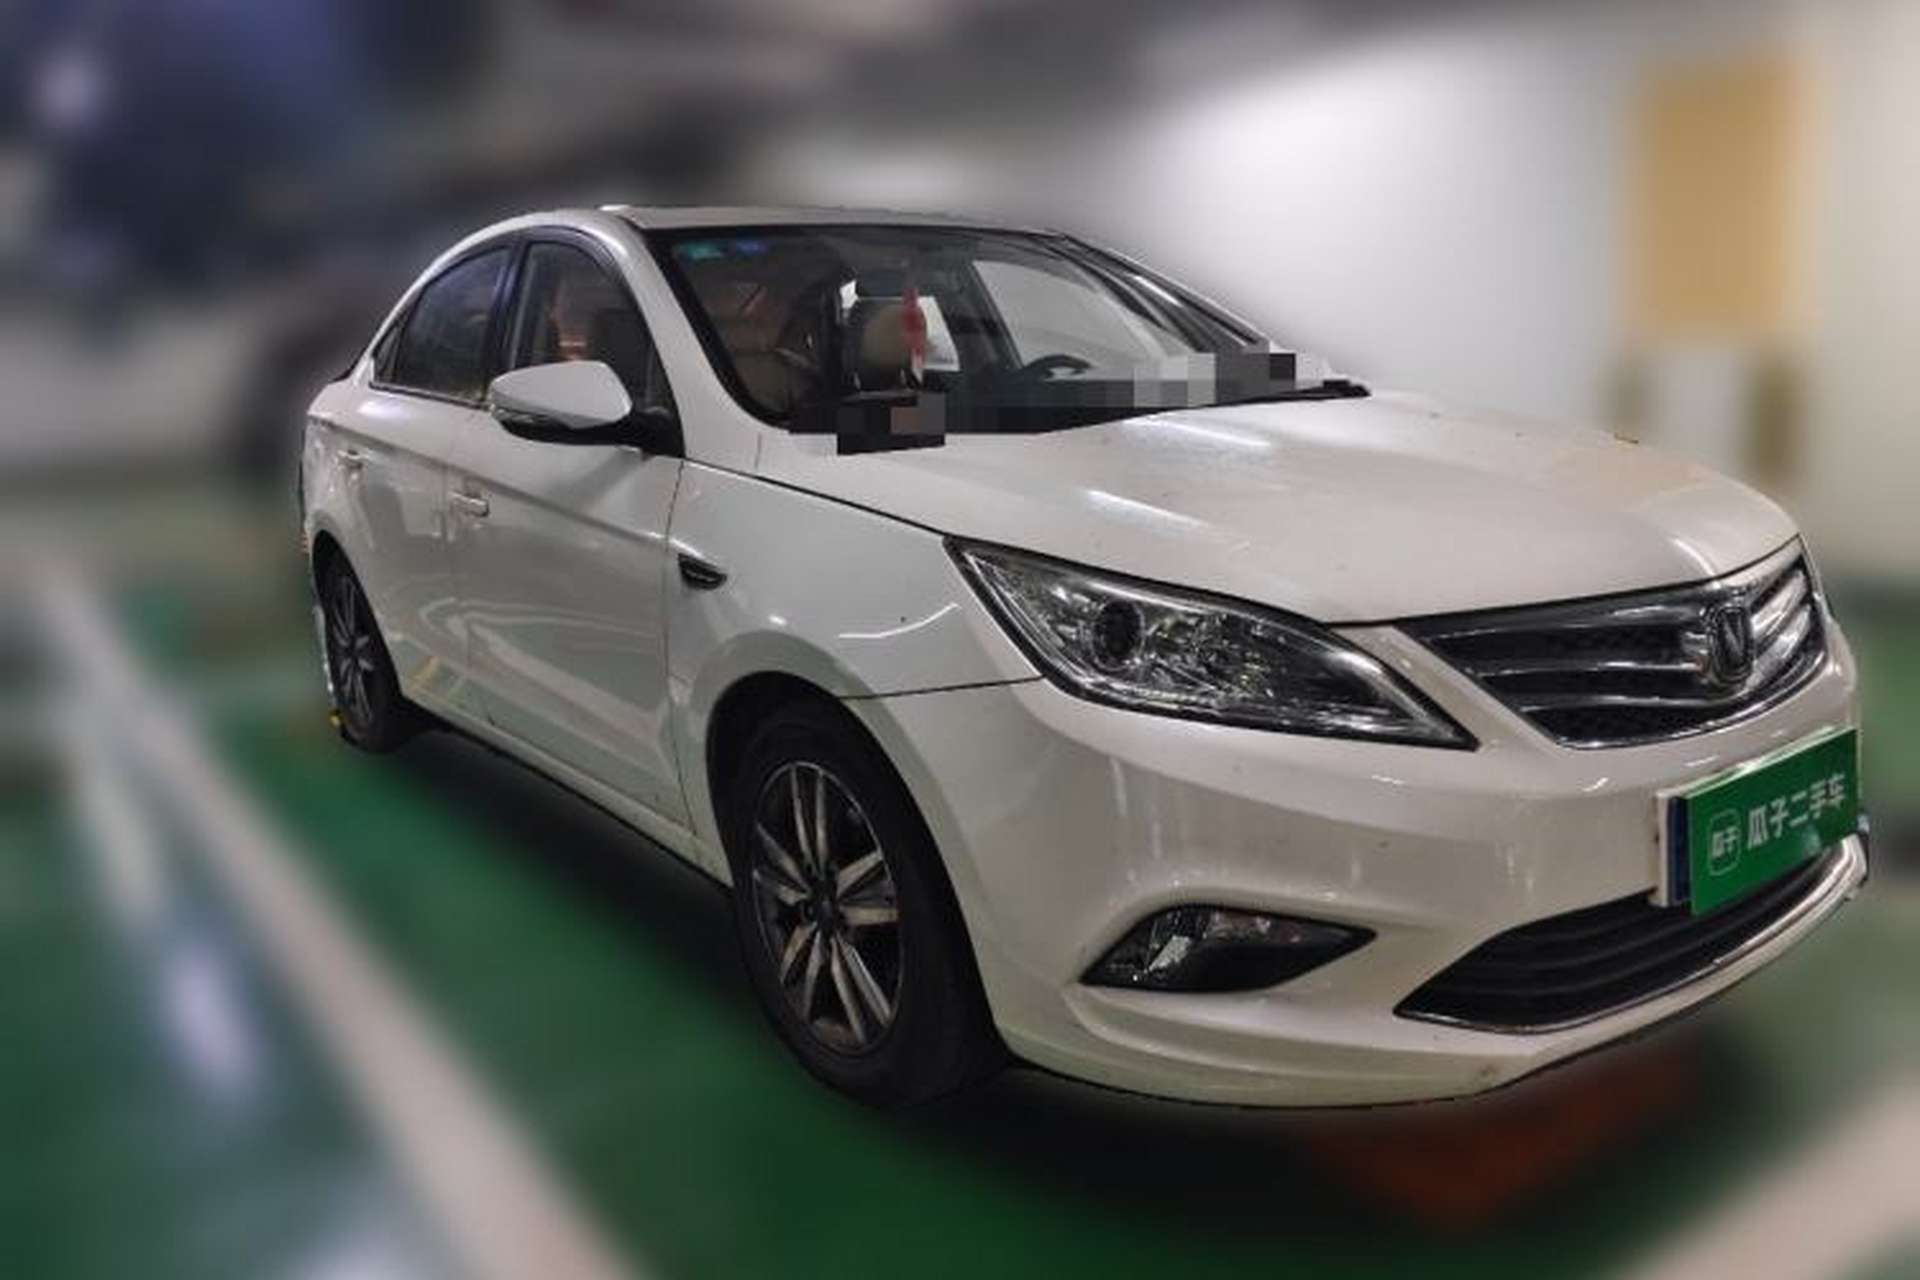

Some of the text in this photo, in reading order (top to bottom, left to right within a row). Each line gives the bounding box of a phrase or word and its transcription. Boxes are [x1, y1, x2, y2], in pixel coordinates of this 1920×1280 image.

[1748, 773, 1845, 848] 瓜子二手车
